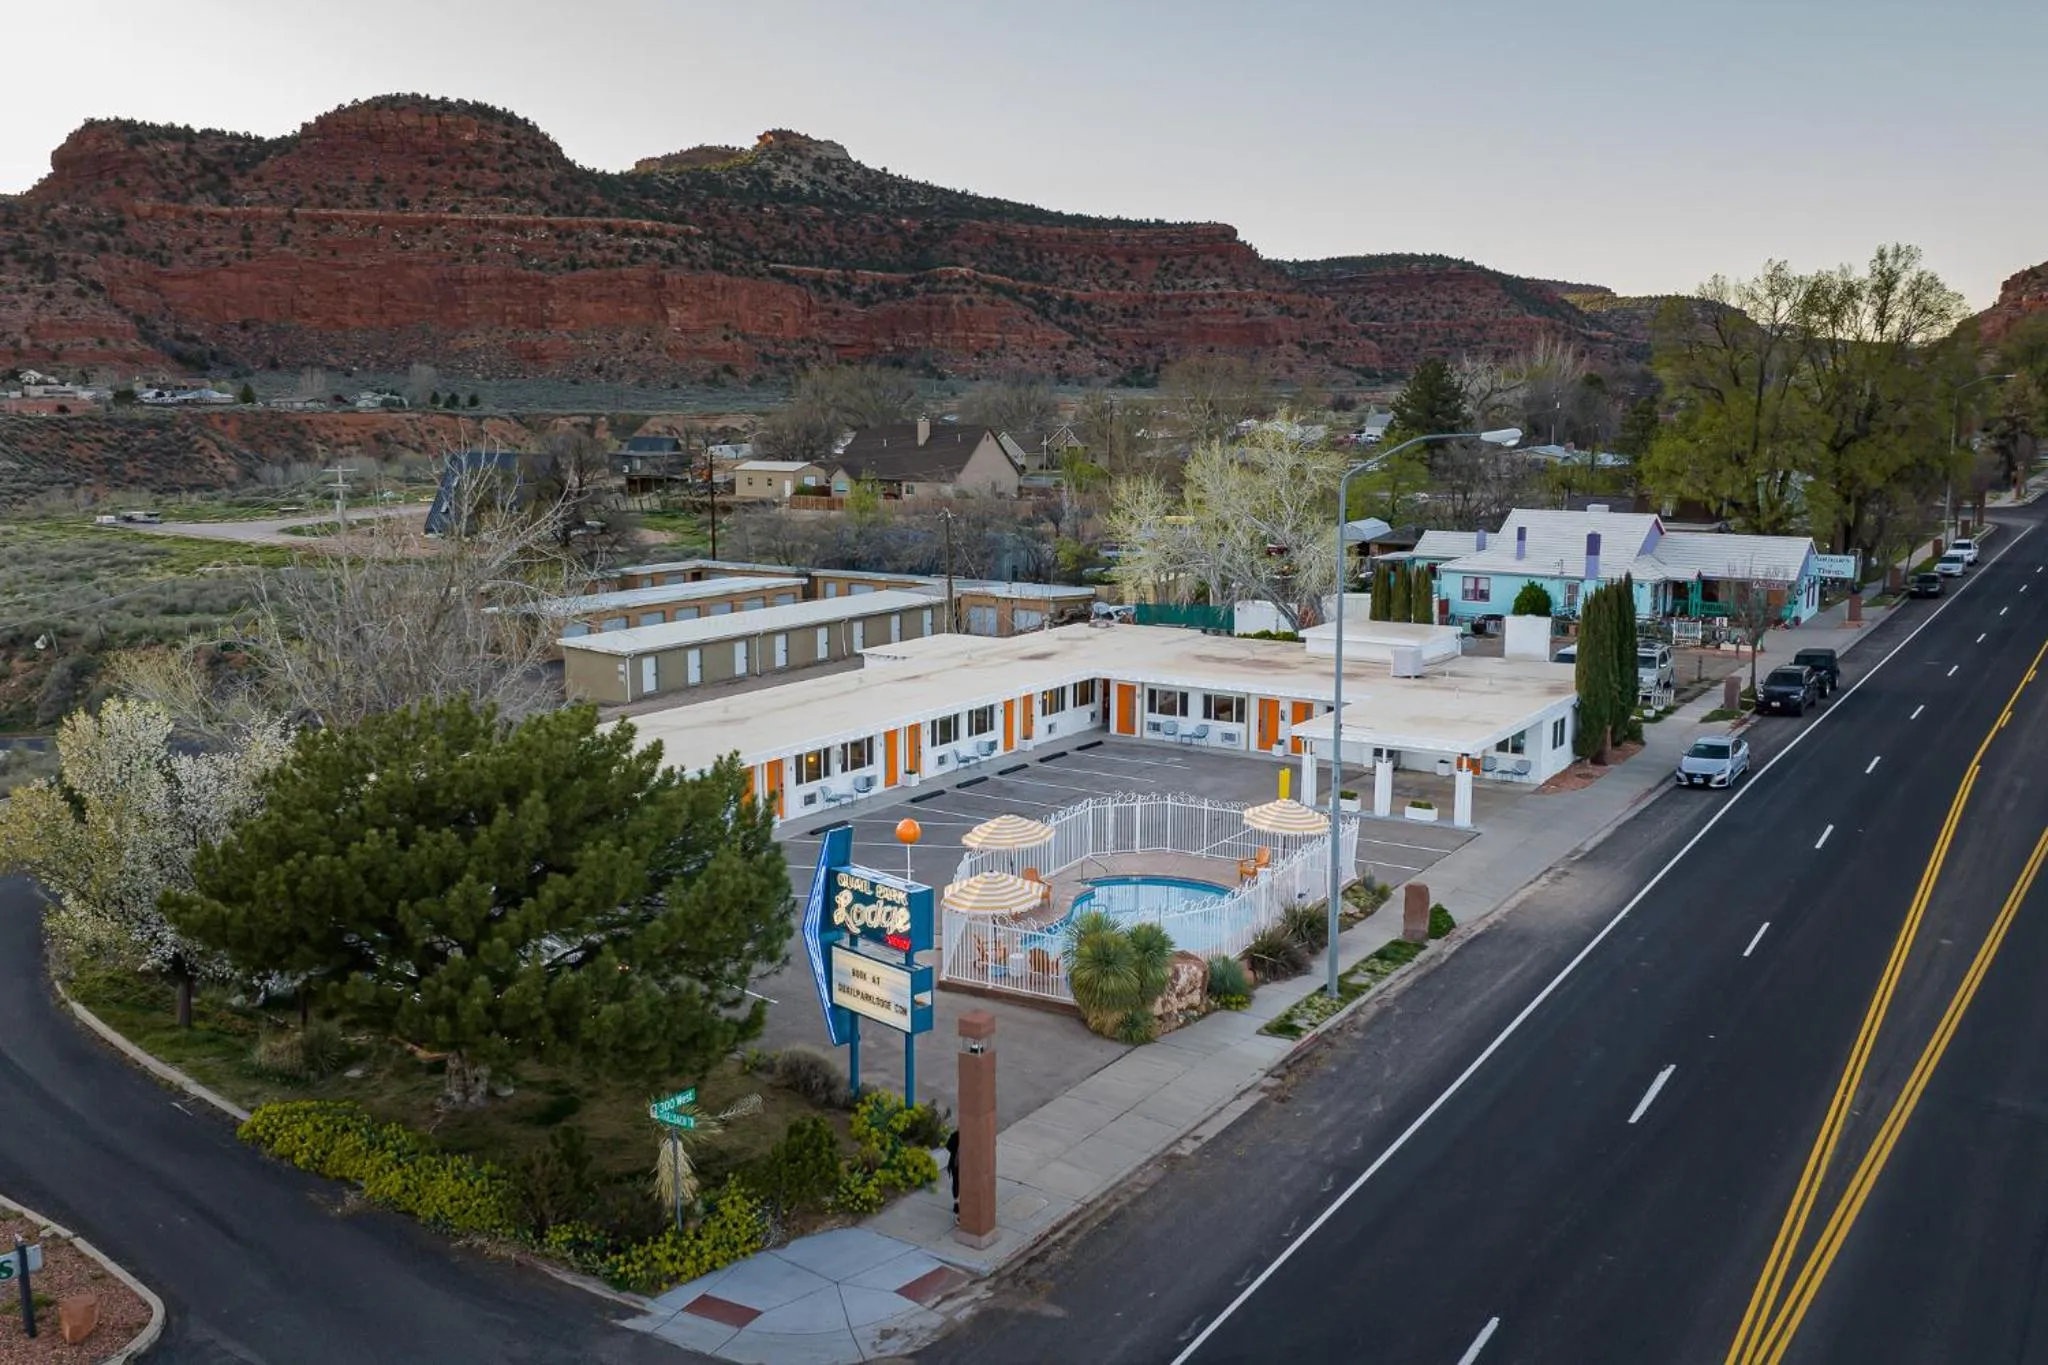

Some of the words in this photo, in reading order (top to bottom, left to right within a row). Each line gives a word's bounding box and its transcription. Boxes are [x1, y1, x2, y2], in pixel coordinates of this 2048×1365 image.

[836, 872, 873, 895] QUAIL
[875, 883, 908, 906] PARK
[833, 889, 911, 934] Lodge
[851, 968, 867, 981] BOOK
[872, 976, 880, 986] AT
[658, 1098, 676, 1113] 300
[676, 1091, 693, 1105] West
